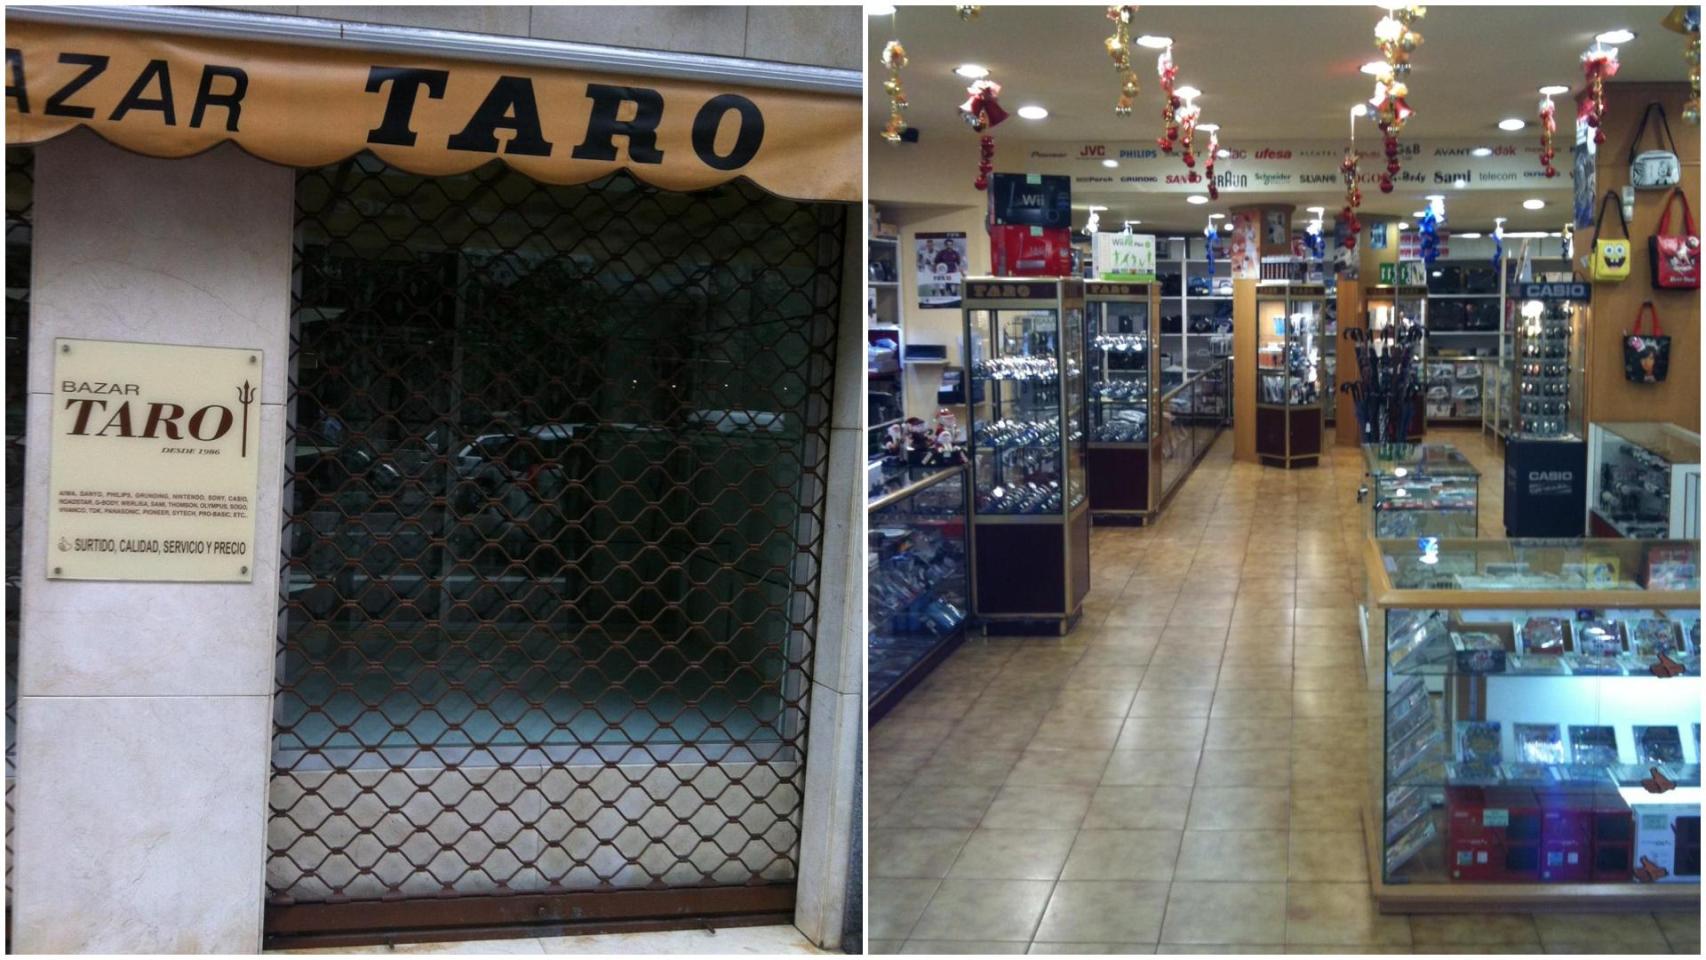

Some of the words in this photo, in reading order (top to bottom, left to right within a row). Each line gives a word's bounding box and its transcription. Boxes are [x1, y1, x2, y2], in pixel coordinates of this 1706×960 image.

[365, 65, 765, 170] TARO
[1080, 145, 1105, 156] JVC
[1119, 149, 1157, 158] PHILIPS
[1255, 148, 1292, 159] ufesa
[1120, 175, 1158, 183] GRUNDIG
[1165, 175, 1202, 184] SANO
[1434, 169, 1471, 184] Sami
[1480, 172, 1517, 182] telecom
[1022, 194, 1045, 206] Wii
[973, 285, 1031, 298] TARO
[1090, 285, 1130, 294] TARO
[1527, 285, 1585, 297] CASIO
[62, 381, 140, 395] BAZAR
[65, 398, 233, 442] TARO
[1528, 471, 1573, 481] CASIO
[74, 538, 117, 555] SURTIDO,
[119, 539, 161, 556] CALIDAD,
[163, 540, 203, 554] SERVICIO
[204, 541, 212, 554] Y
[214, 541, 246, 555] PRECIO
